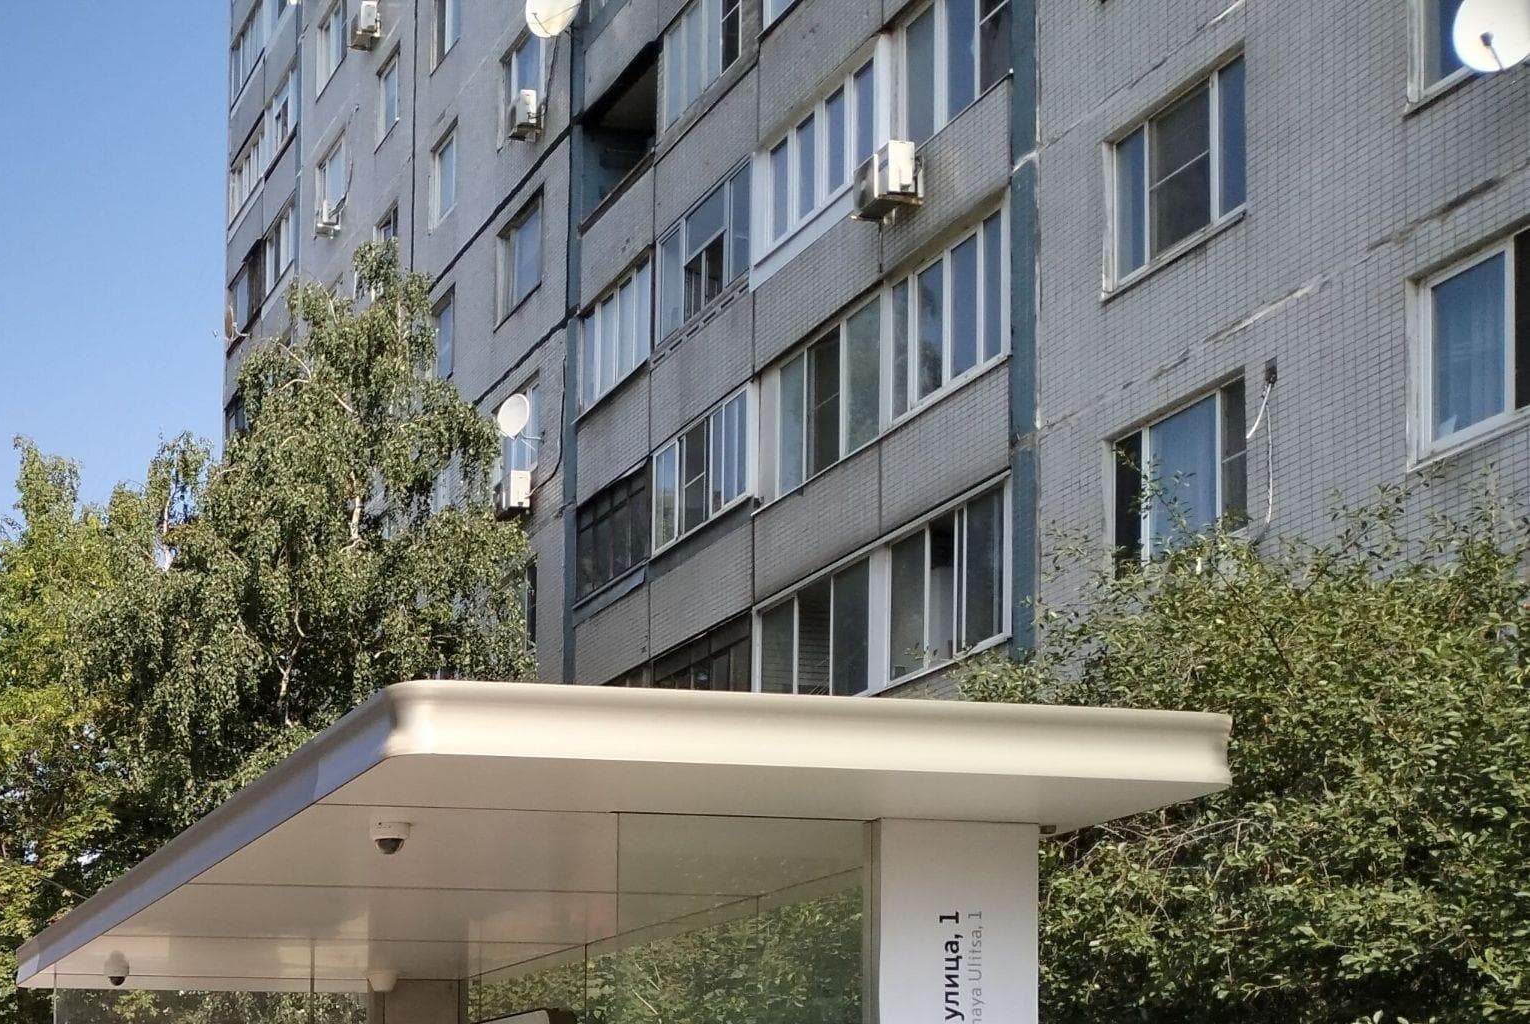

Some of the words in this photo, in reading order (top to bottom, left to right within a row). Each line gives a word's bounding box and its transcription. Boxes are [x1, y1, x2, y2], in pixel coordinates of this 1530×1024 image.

[939, 910, 960, 925] 1
[967, 910, 982, 920] 1
[967, 925, 983, 982] Ulitsa,
[944, 933, 965, 1022] улица,
